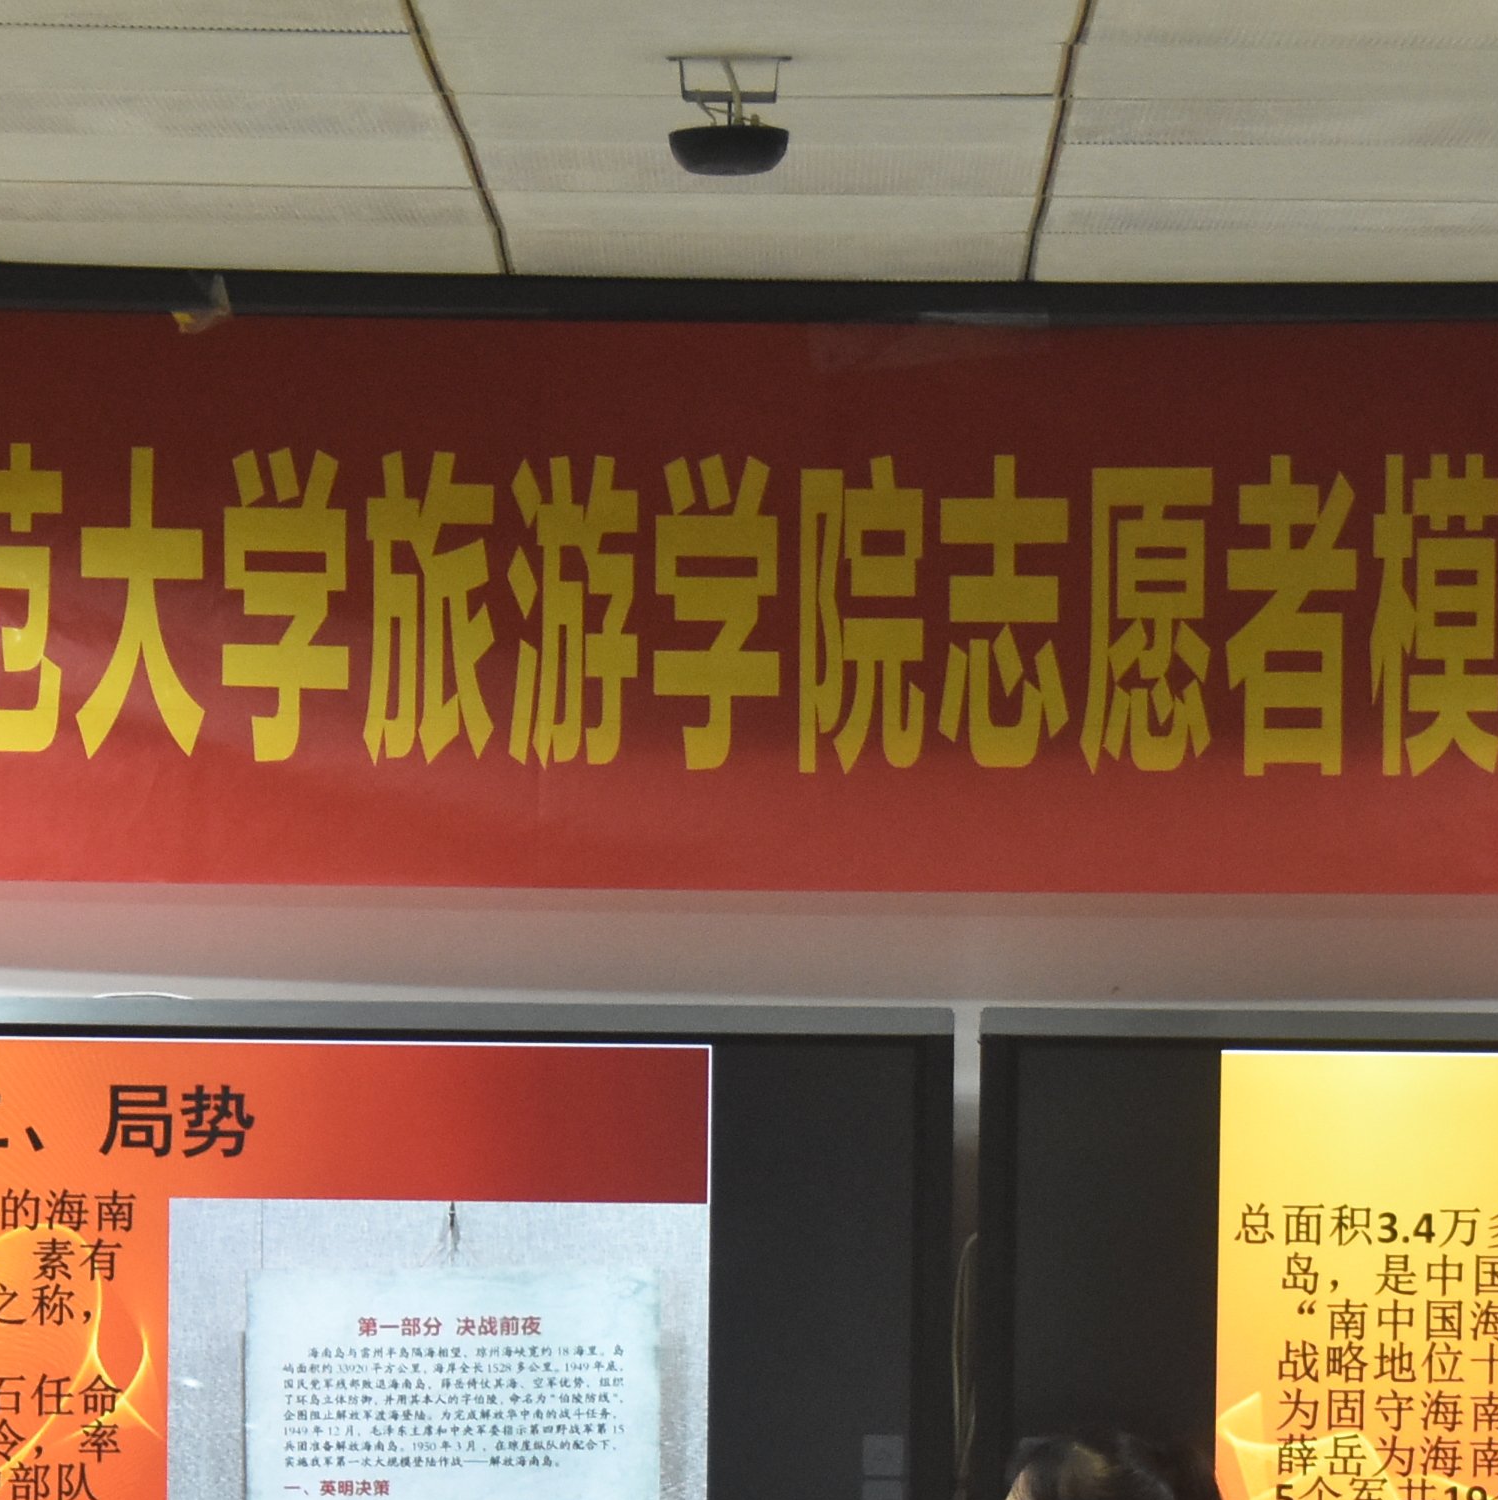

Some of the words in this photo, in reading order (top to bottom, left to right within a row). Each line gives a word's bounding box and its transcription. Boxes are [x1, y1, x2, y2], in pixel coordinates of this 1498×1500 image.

[358, 1317, 441, 1337] 第一部分
[456, 1316, 542, 1336] 决战前夜
[284, 1479, 390, 1497] 一、英明决策
